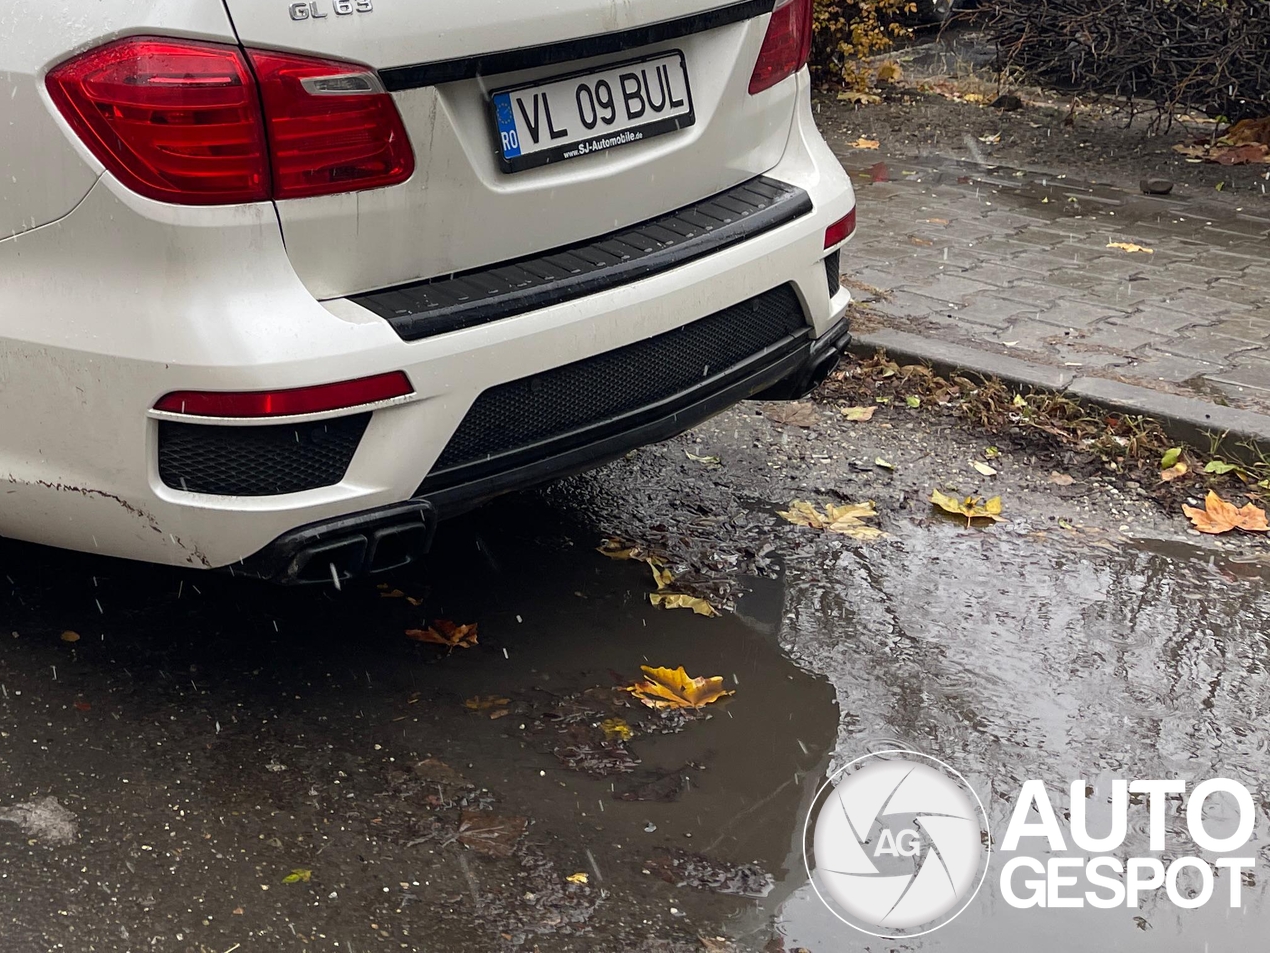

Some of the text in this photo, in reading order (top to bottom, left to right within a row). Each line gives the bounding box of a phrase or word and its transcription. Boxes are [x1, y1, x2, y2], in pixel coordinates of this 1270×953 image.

[289, 1, 328, 21] GL
[516, 64, 684, 144] VL 09 BUL
[501, 131, 519, 151] RO
[563, 131, 643, 159] www.SJ-Automobile.de
